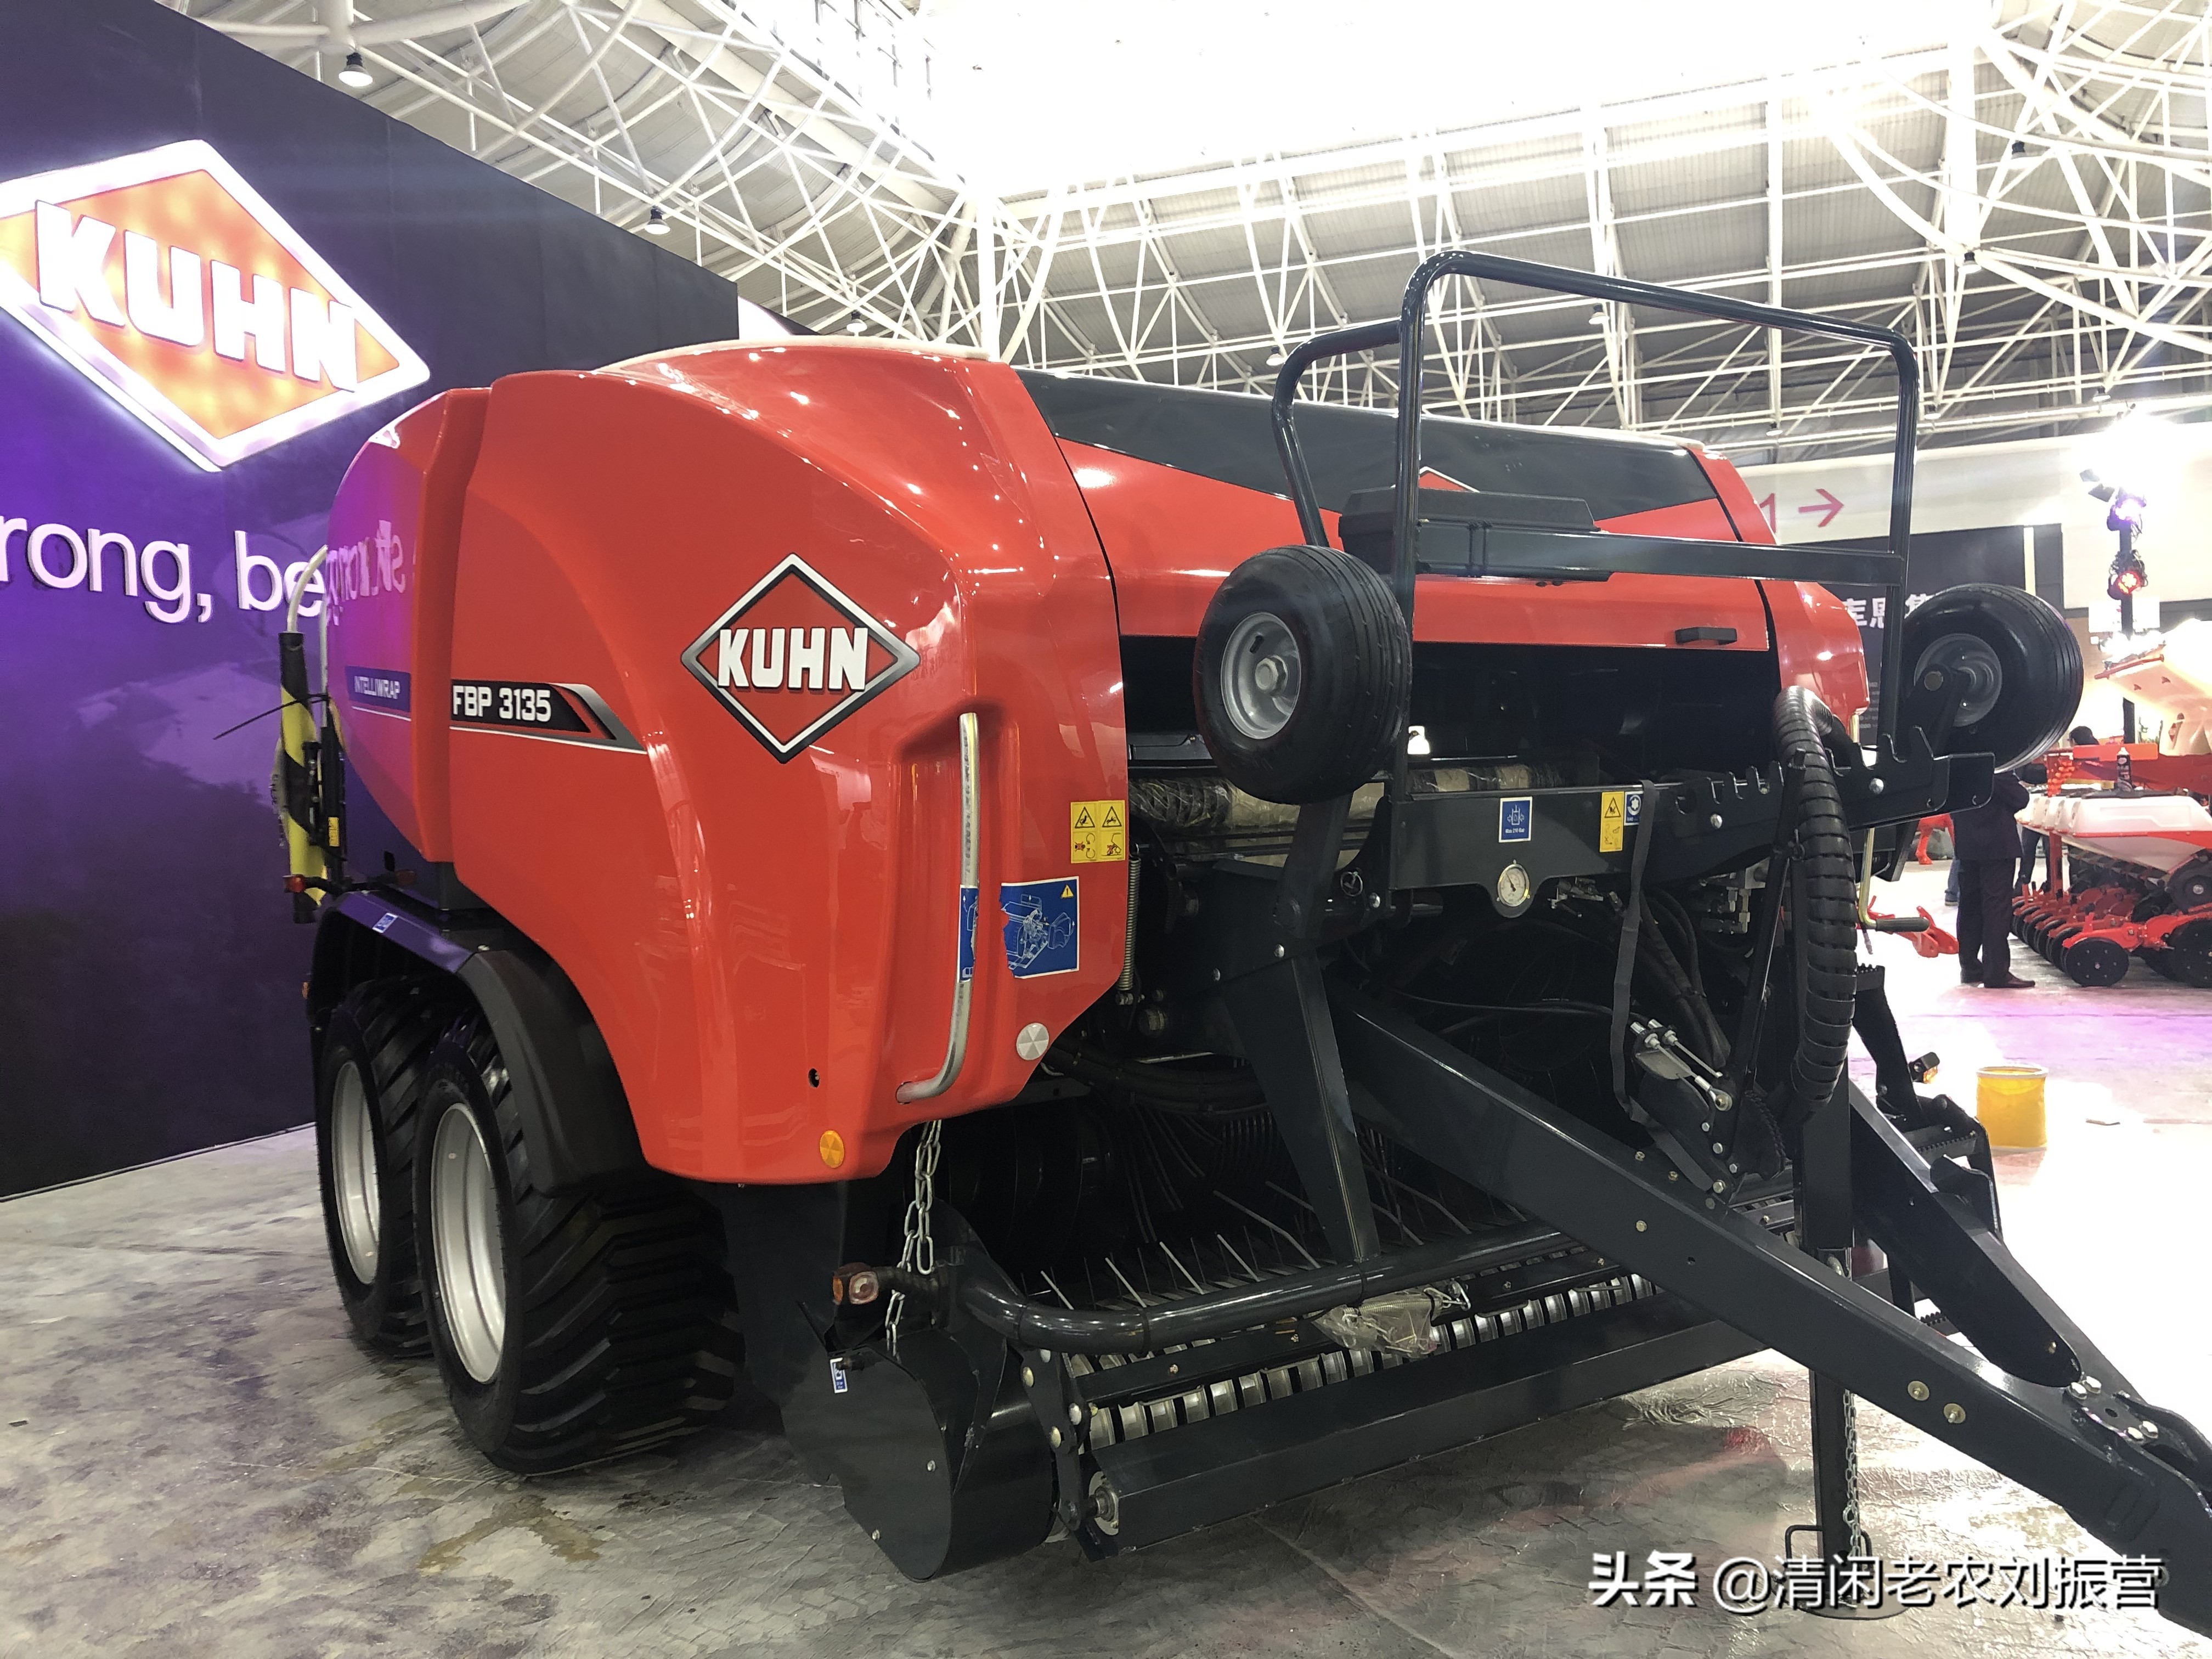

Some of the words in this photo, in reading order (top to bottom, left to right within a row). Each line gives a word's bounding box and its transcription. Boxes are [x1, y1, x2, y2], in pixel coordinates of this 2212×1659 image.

[35, 200, 356, 393] KUHN
[235, 531, 325, 617] be
[718, 627, 868, 690] KUHN
[453, 685, 492, 717] FBP
[499, 687, 551, 722] 3135
